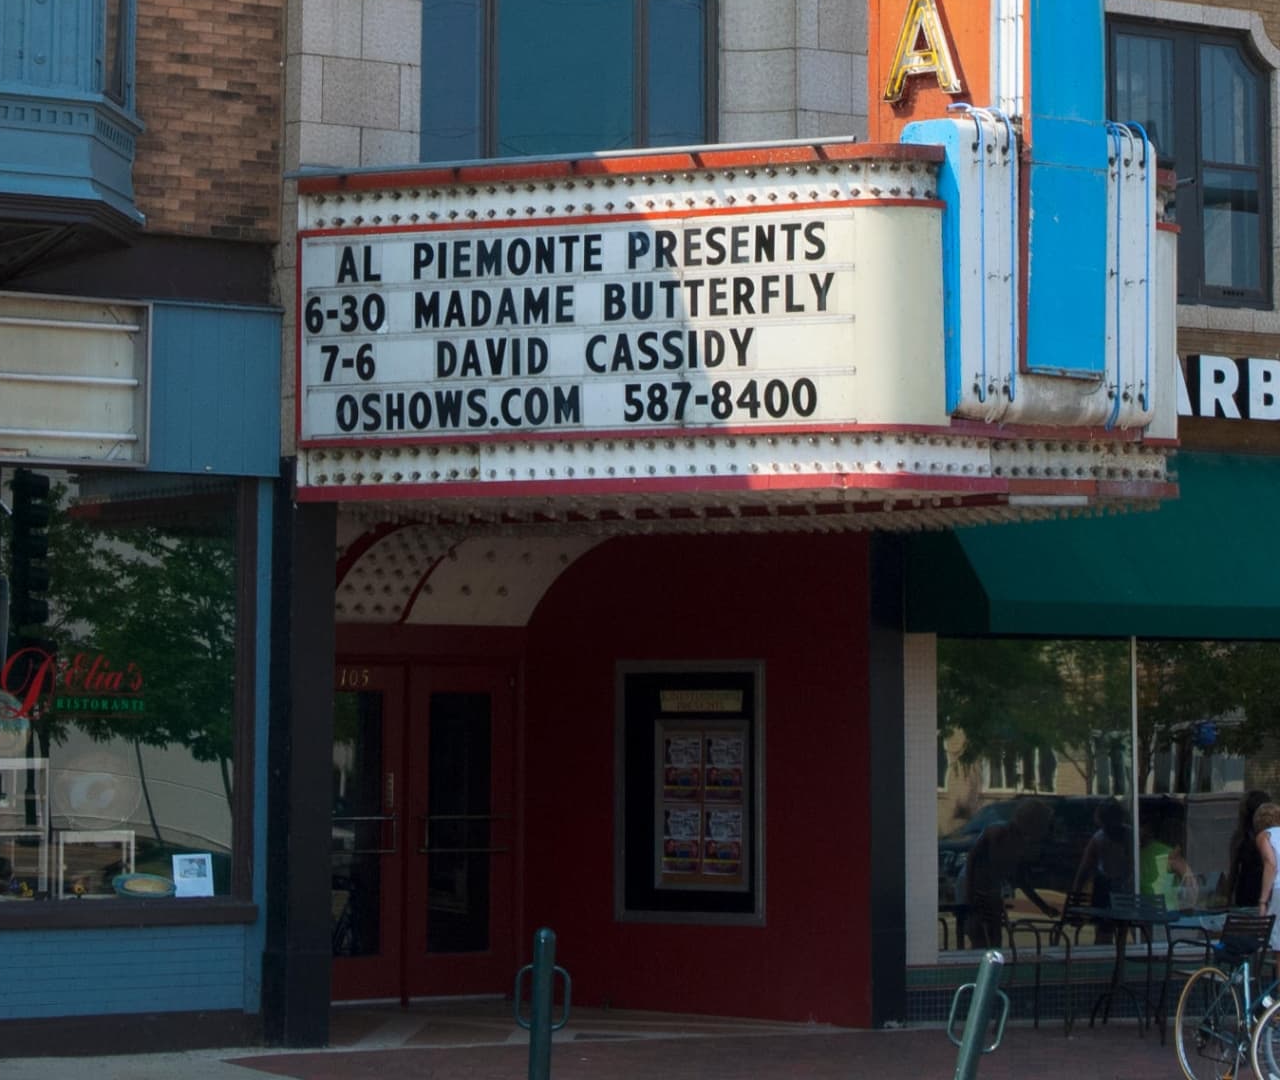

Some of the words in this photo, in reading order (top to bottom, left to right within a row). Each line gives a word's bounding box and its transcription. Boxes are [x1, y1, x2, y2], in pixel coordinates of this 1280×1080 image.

[337, 245, 381, 283] AL
[413, 233, 603, 280] PIEMONTE
[627, 221, 826, 270] PRESENTS
[305, 293, 385, 334] 6-30
[414, 285, 574, 329] MADAME
[604, 271, 835, 321] BUTTERFLY
[320, 343, 376, 382] 7-6
[437, 337, 548, 378] DAVID
[585, 327, 754, 374] CASSIDY
[336, 385, 580, 432] OSHOWS.COM
[624, 377, 817, 423] 587-8400
[56, 697, 145, 712] RISTORANTE
[340, 669, 369, 687] 105
